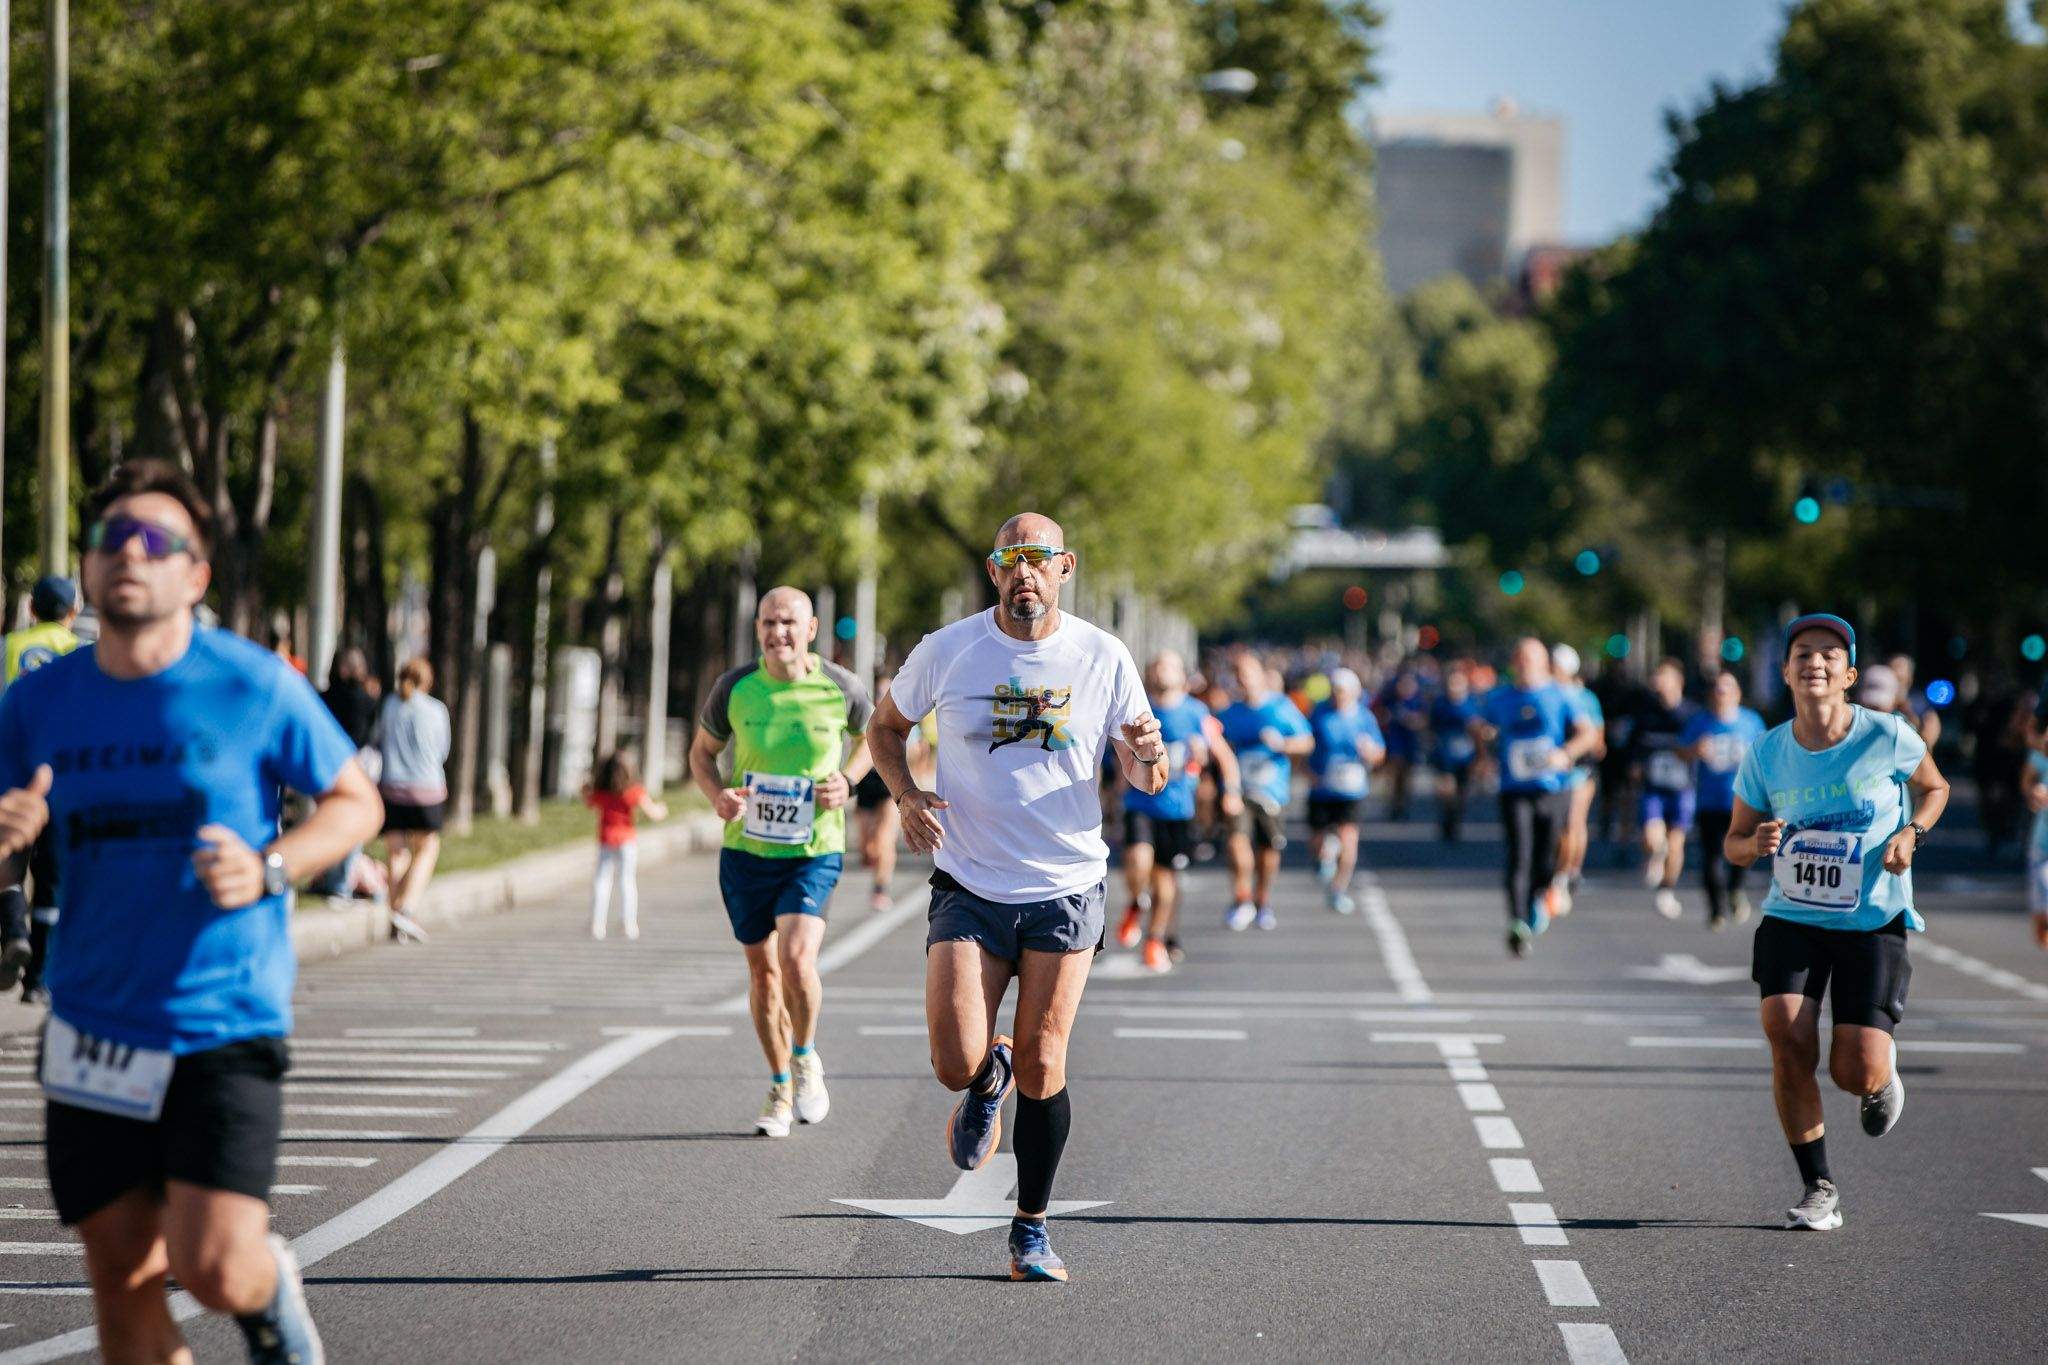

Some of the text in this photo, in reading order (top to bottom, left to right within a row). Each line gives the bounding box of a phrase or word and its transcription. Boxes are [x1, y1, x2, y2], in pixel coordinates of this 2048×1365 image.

[993, 699, 1072, 715] Linal
[1775, 775, 1881, 807] DECIMAS
[756, 803, 798, 824] 1522
[1799, 853, 1845, 863] DECIMAS
[1793, 862, 1842, 888] 1410
